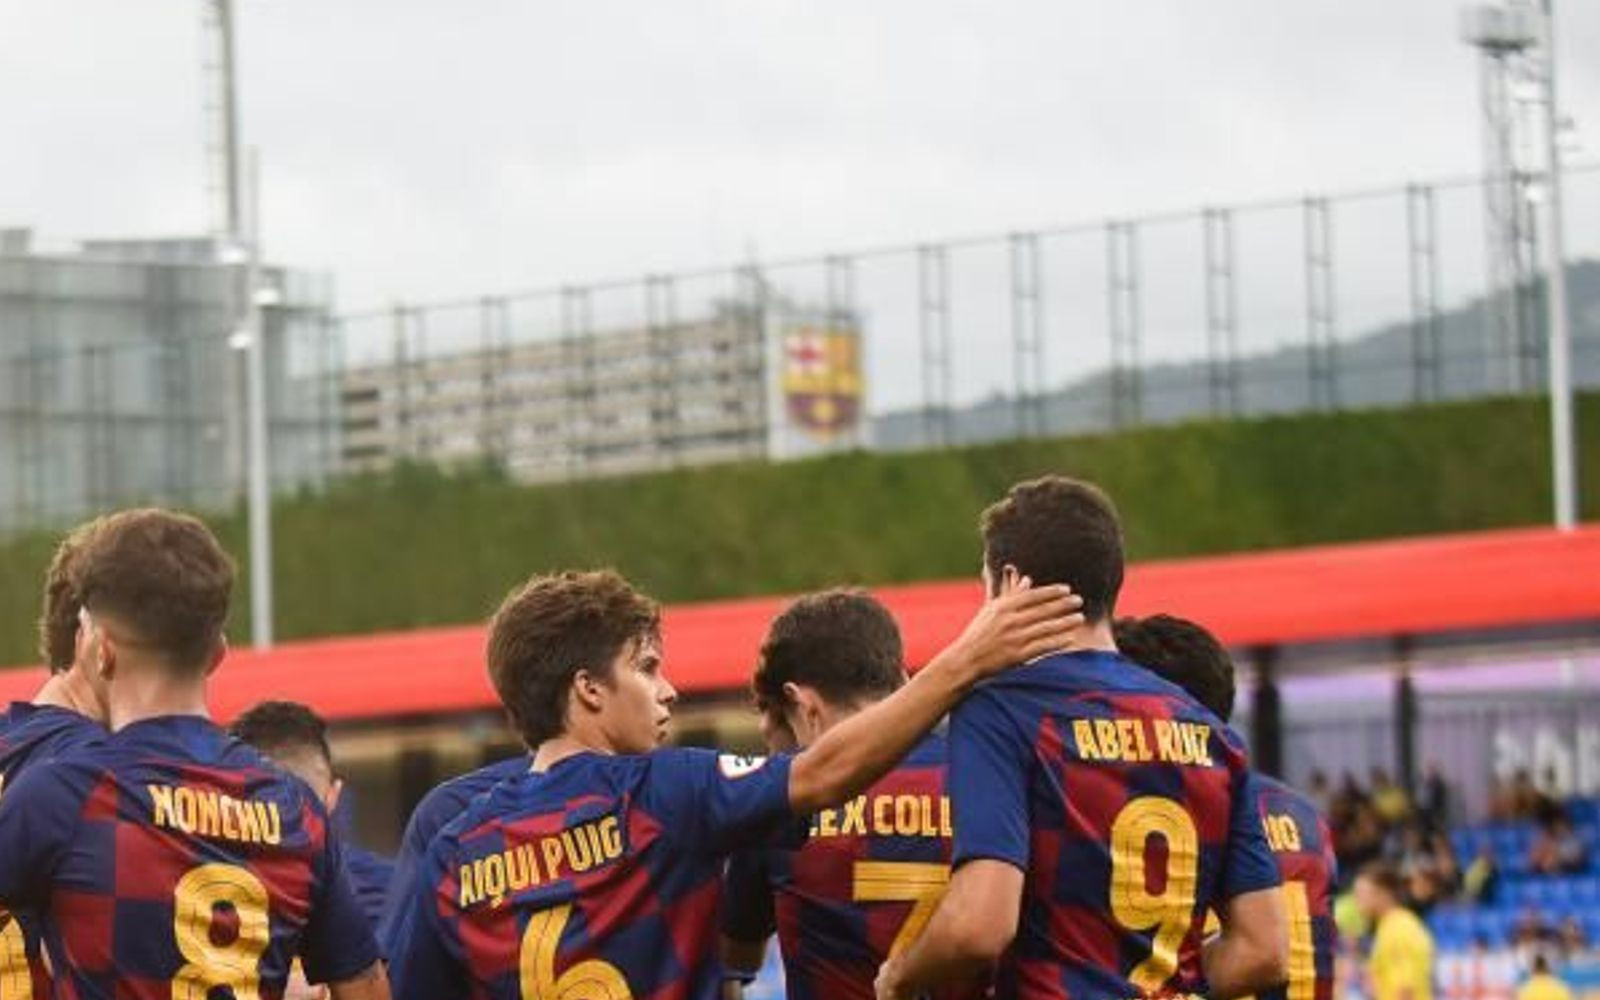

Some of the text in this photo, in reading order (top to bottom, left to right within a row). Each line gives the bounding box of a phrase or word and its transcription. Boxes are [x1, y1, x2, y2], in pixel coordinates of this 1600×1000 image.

[1072, 719, 1213, 767] ABEL RUIZ
[147, 784, 281, 845] MONCHU
[541, 816, 624, 880] PUIG
[1111, 796, 1197, 996] 9
